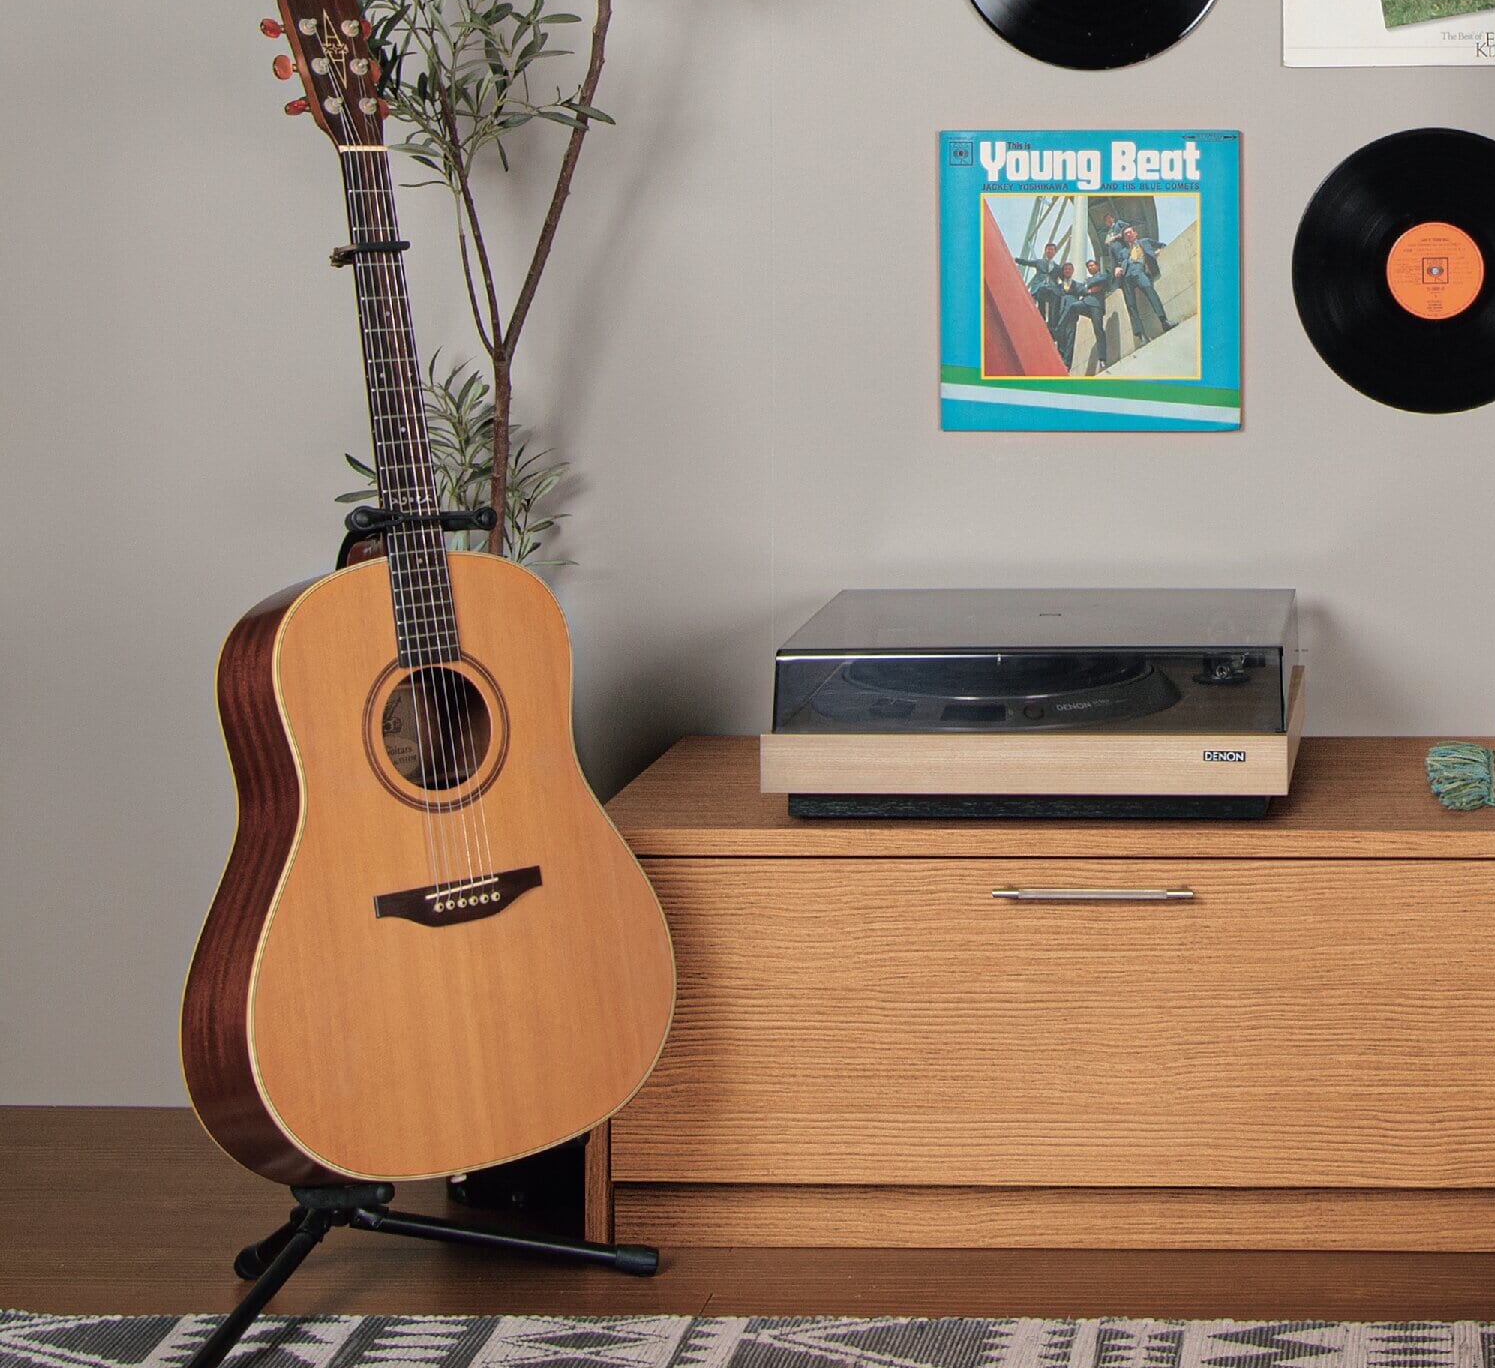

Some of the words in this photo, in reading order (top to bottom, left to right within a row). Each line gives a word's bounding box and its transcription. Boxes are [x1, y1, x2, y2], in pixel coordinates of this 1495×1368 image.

[1441, 32, 1457, 41] The
[1458, 32, 1473, 41] Best
[1007, 142, 1023, 150] This
[1024, 142, 1031, 150] is
[979, 141, 1101, 190] Young
[1111, 141, 1200, 181] Beat
[982, 183, 1014, 191] JACKEY
[1018, 183, 1069, 191] YOSHIKAWA
[1101, 182, 1119, 190] AND
[1122, 182, 1136, 190] HIS
[1140, 182, 1161, 190] BLUE
[1165, 182, 1200, 190] COMETS
[1204, 751, 1244, 761] DENON
